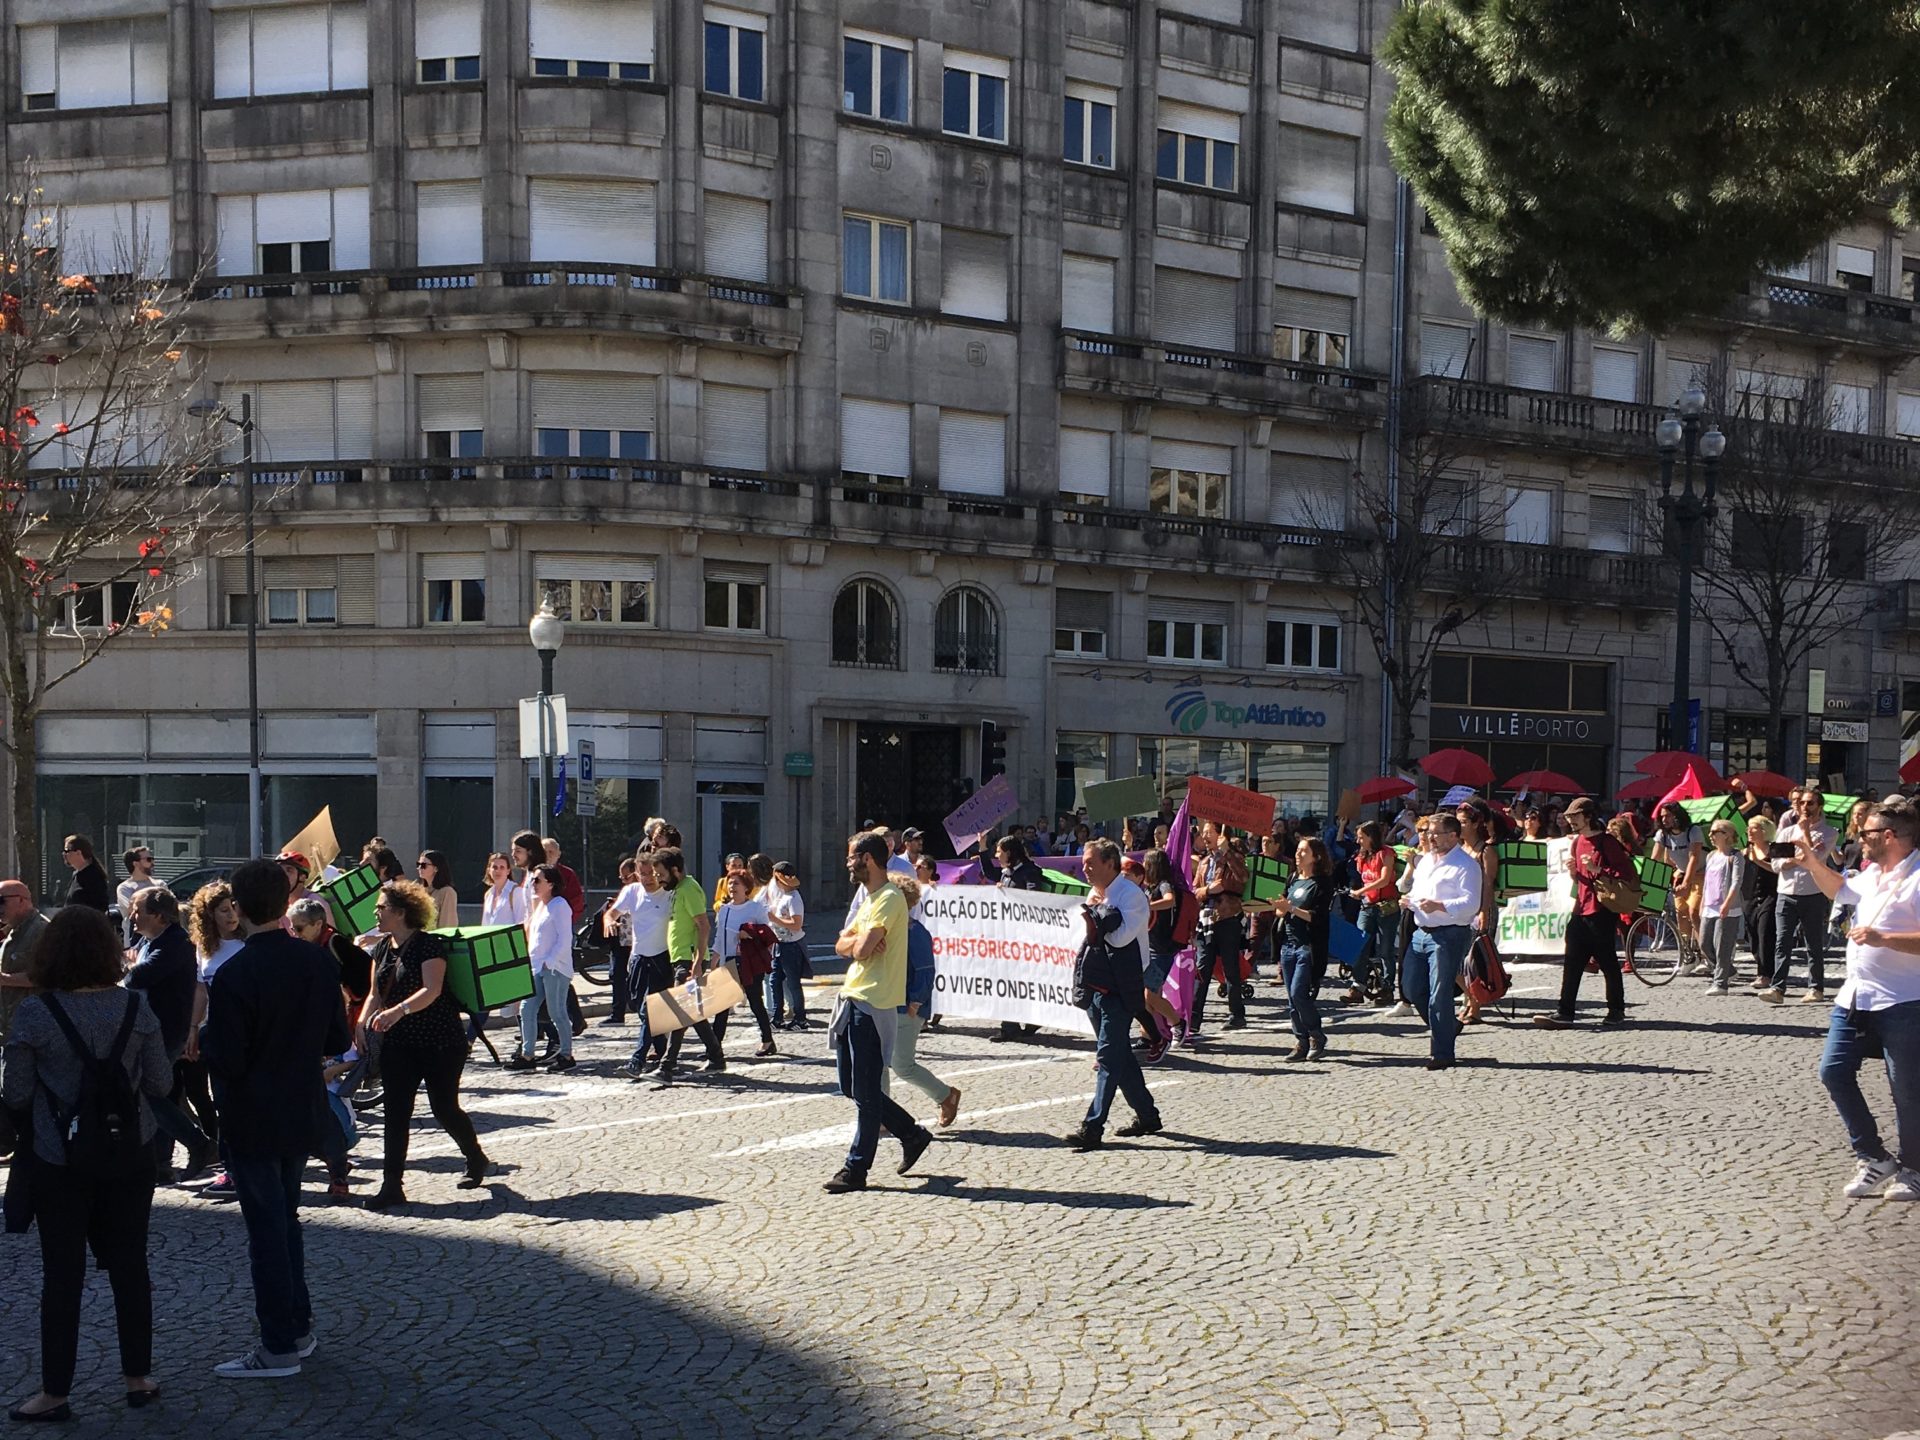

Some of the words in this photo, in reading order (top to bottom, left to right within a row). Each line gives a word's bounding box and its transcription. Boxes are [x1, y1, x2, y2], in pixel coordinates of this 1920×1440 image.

[1210, 701, 1326, 728] TopAtlântico
[583, 757, 590, 777] P
[921, 895, 977, 924] CIAÇÃO
[981, 901, 998, 920] DE
[1001, 901, 1070, 929] MORADORES
[946, 934, 1021, 961] HISTÓRICO
[1023, 943, 1042, 963] DO
[949, 975, 993, 996] VIVER
[996, 979, 1036, 1001] ONDE
[1038, 983, 1073, 1006] NASC
